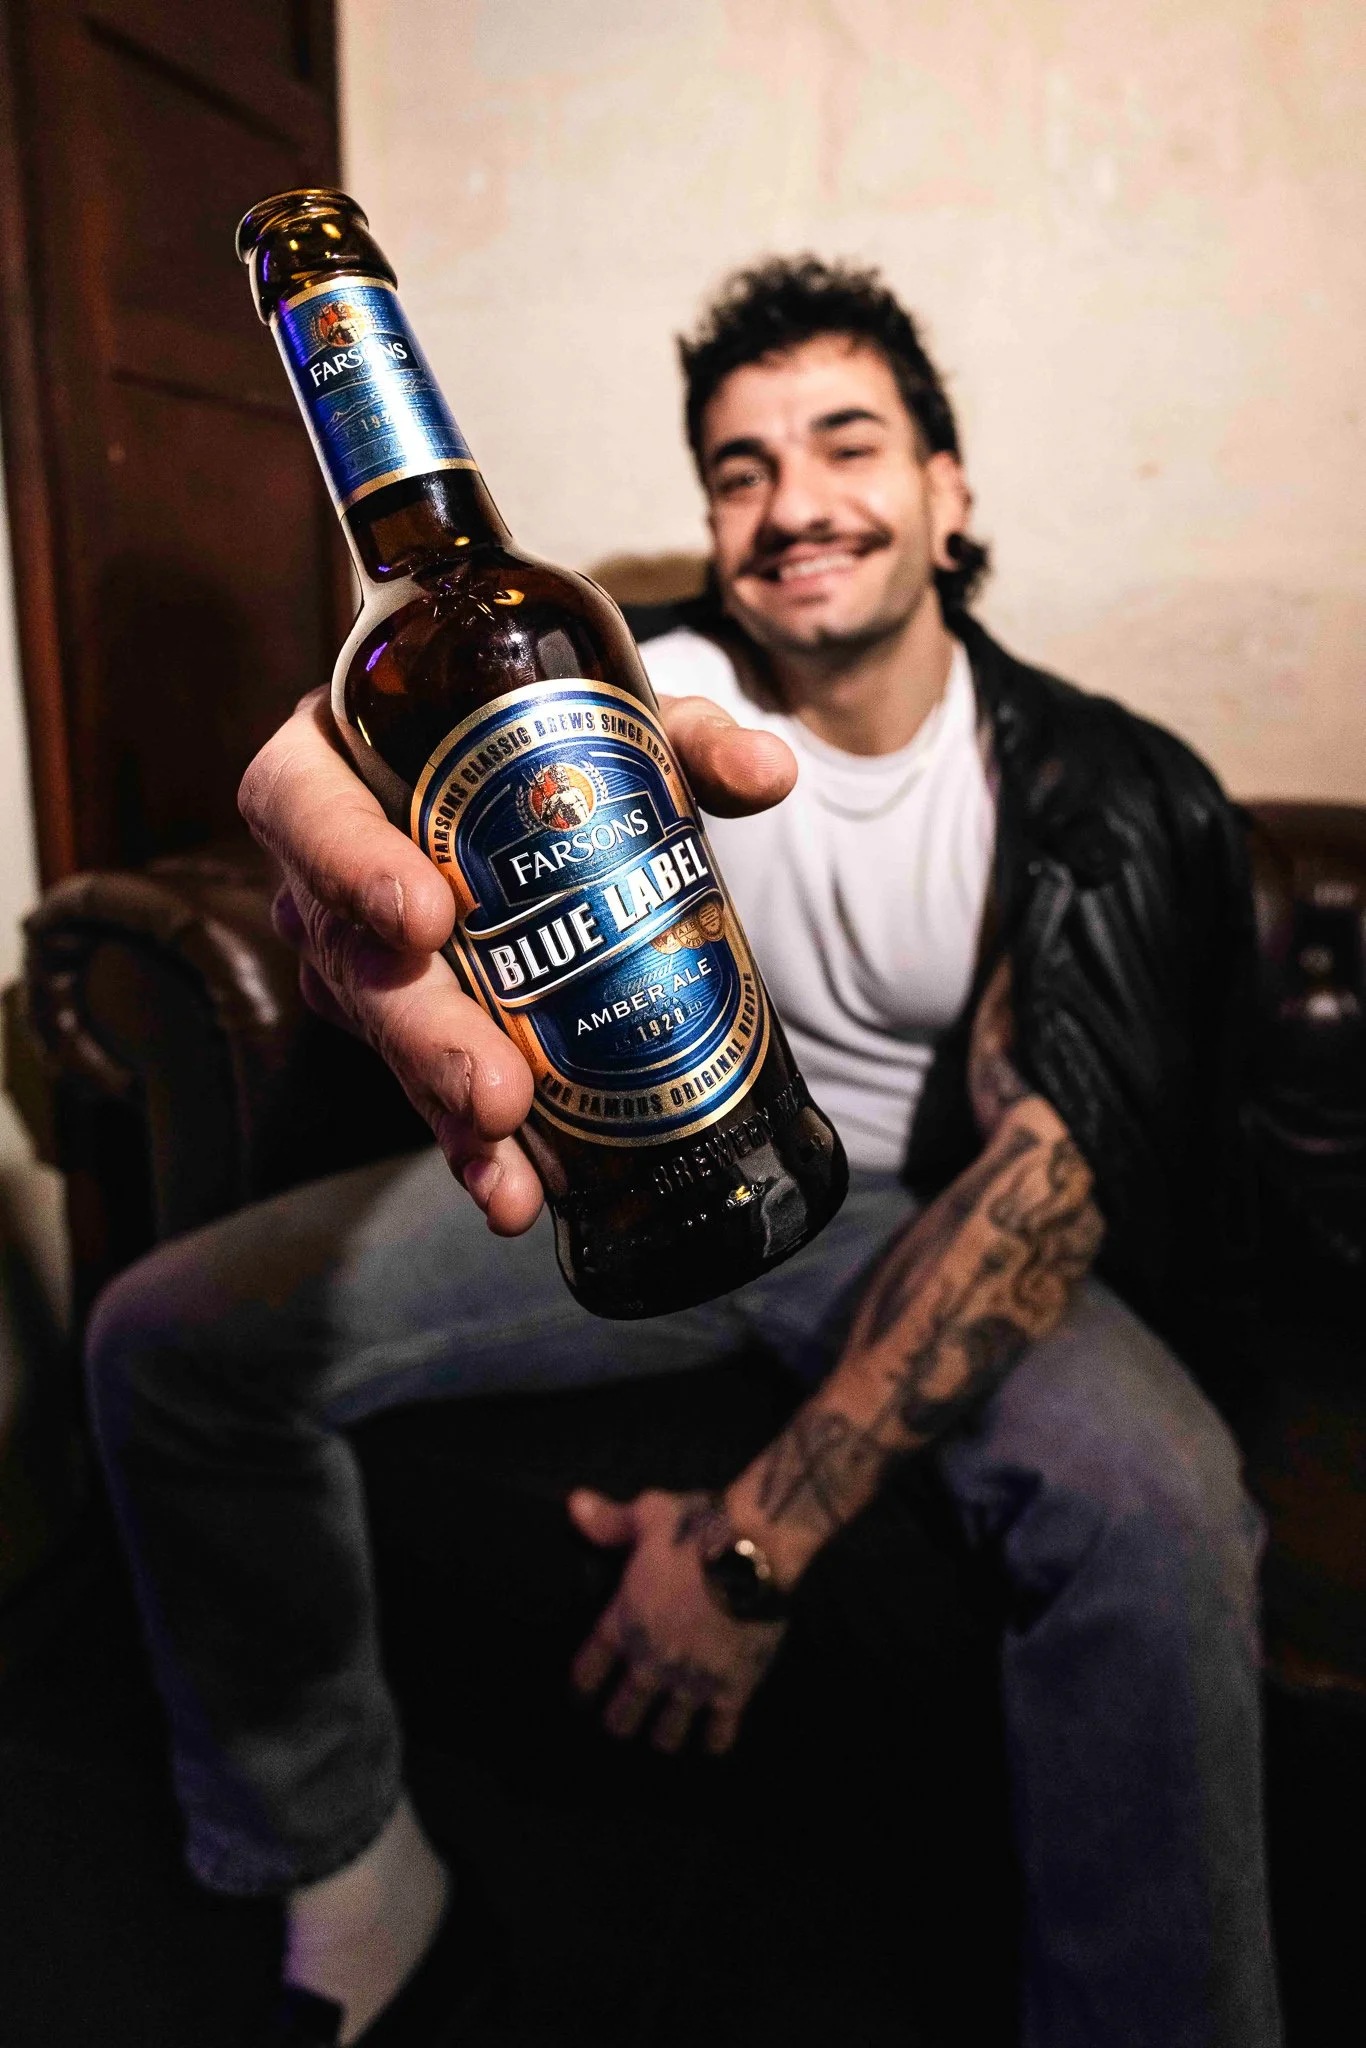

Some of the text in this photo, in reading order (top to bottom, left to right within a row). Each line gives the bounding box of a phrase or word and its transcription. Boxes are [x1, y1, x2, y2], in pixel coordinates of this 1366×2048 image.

[309, 342, 408, 388] FARSNS
[434, 783, 468, 864] FARSONS
[460, 726, 531, 785] CLASSIC
[600, 713, 643, 746] SINCE
[509, 808, 650, 887] FARSONS
[488, 837, 709, 993] BLUE LABEL
[576, 957, 712, 1036] AMBER ALE
[636, 1007, 685, 1042] 1928
[579, 1093, 664, 1119] FAMOUS
[669, 1037, 746, 1107] ORIGINAL
[737, 972, 756, 1038] RECIPE
